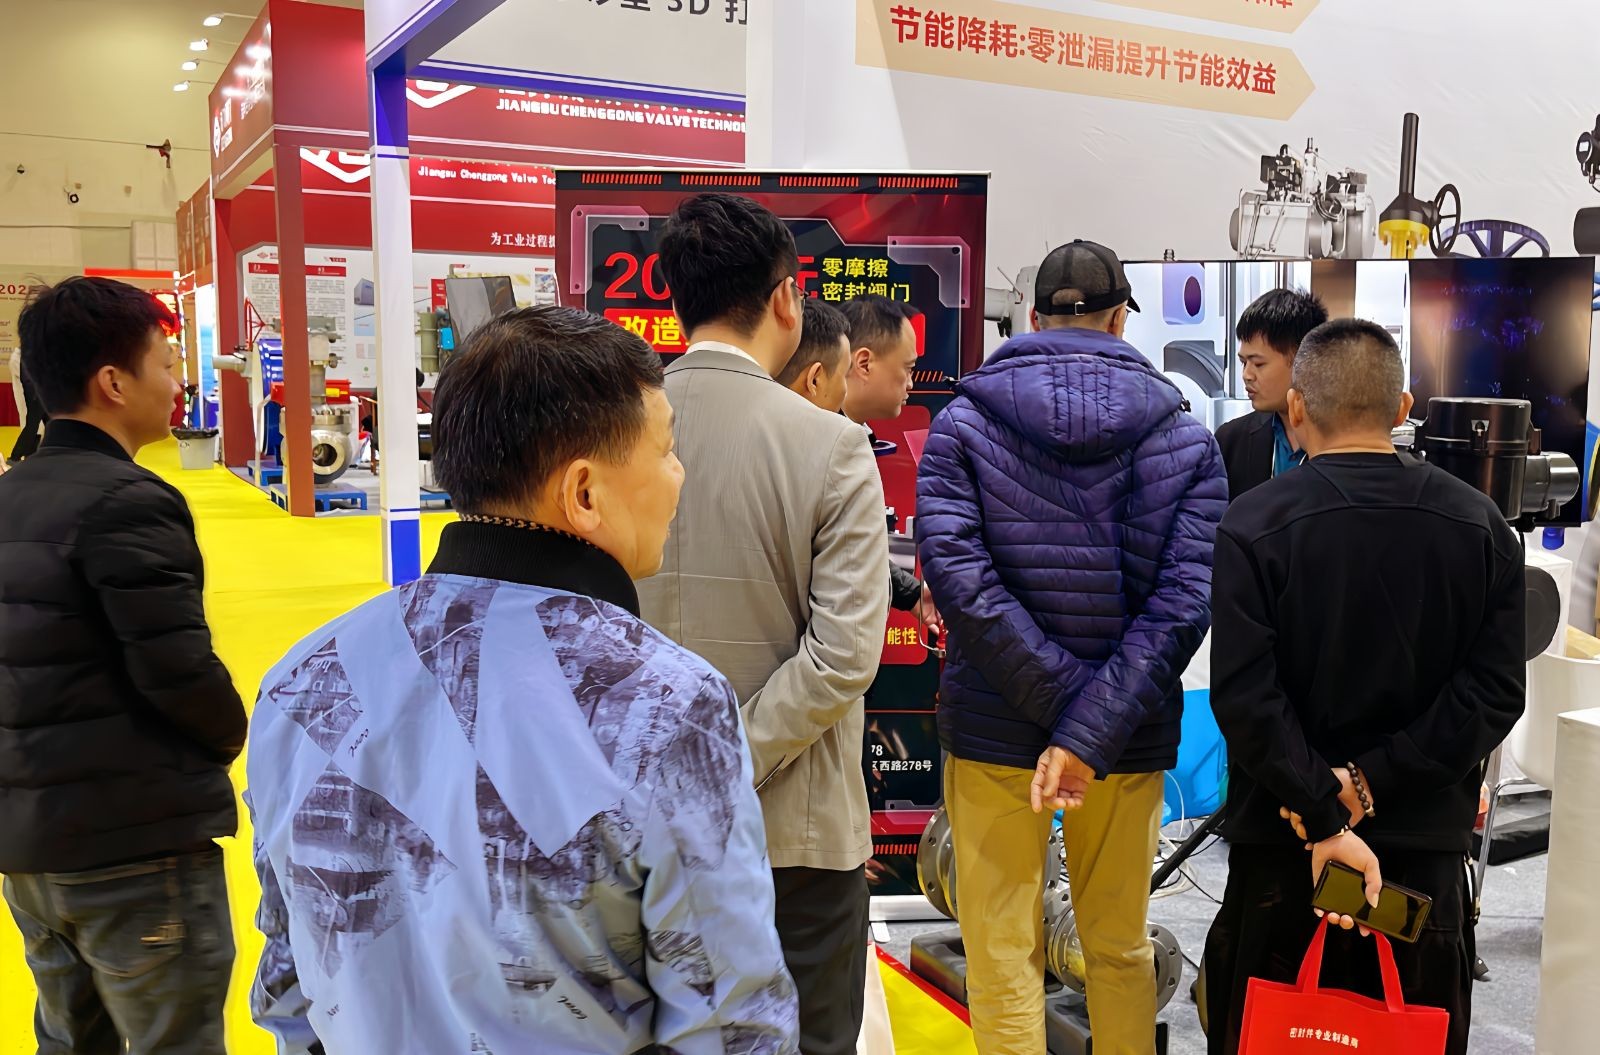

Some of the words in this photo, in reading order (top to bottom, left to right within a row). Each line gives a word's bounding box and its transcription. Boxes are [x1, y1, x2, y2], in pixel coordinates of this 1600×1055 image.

[889, 5, 1277, 95] 节能降耗:零泄漏提升节能效益
[561, 104, 644, 123] CHENGGONG
[645, 112, 690, 128] VALVE
[418, 166, 456, 179] Jiangsu
[460, 168, 508, 183] Chenggong
[511, 172, 538, 184] Valve
[822, 258, 889, 278] 零摩擦
[822, 281, 910, 302] 密封阀门
[618, 315, 690, 346] 改造
[887, 627, 918, 646] 能性
